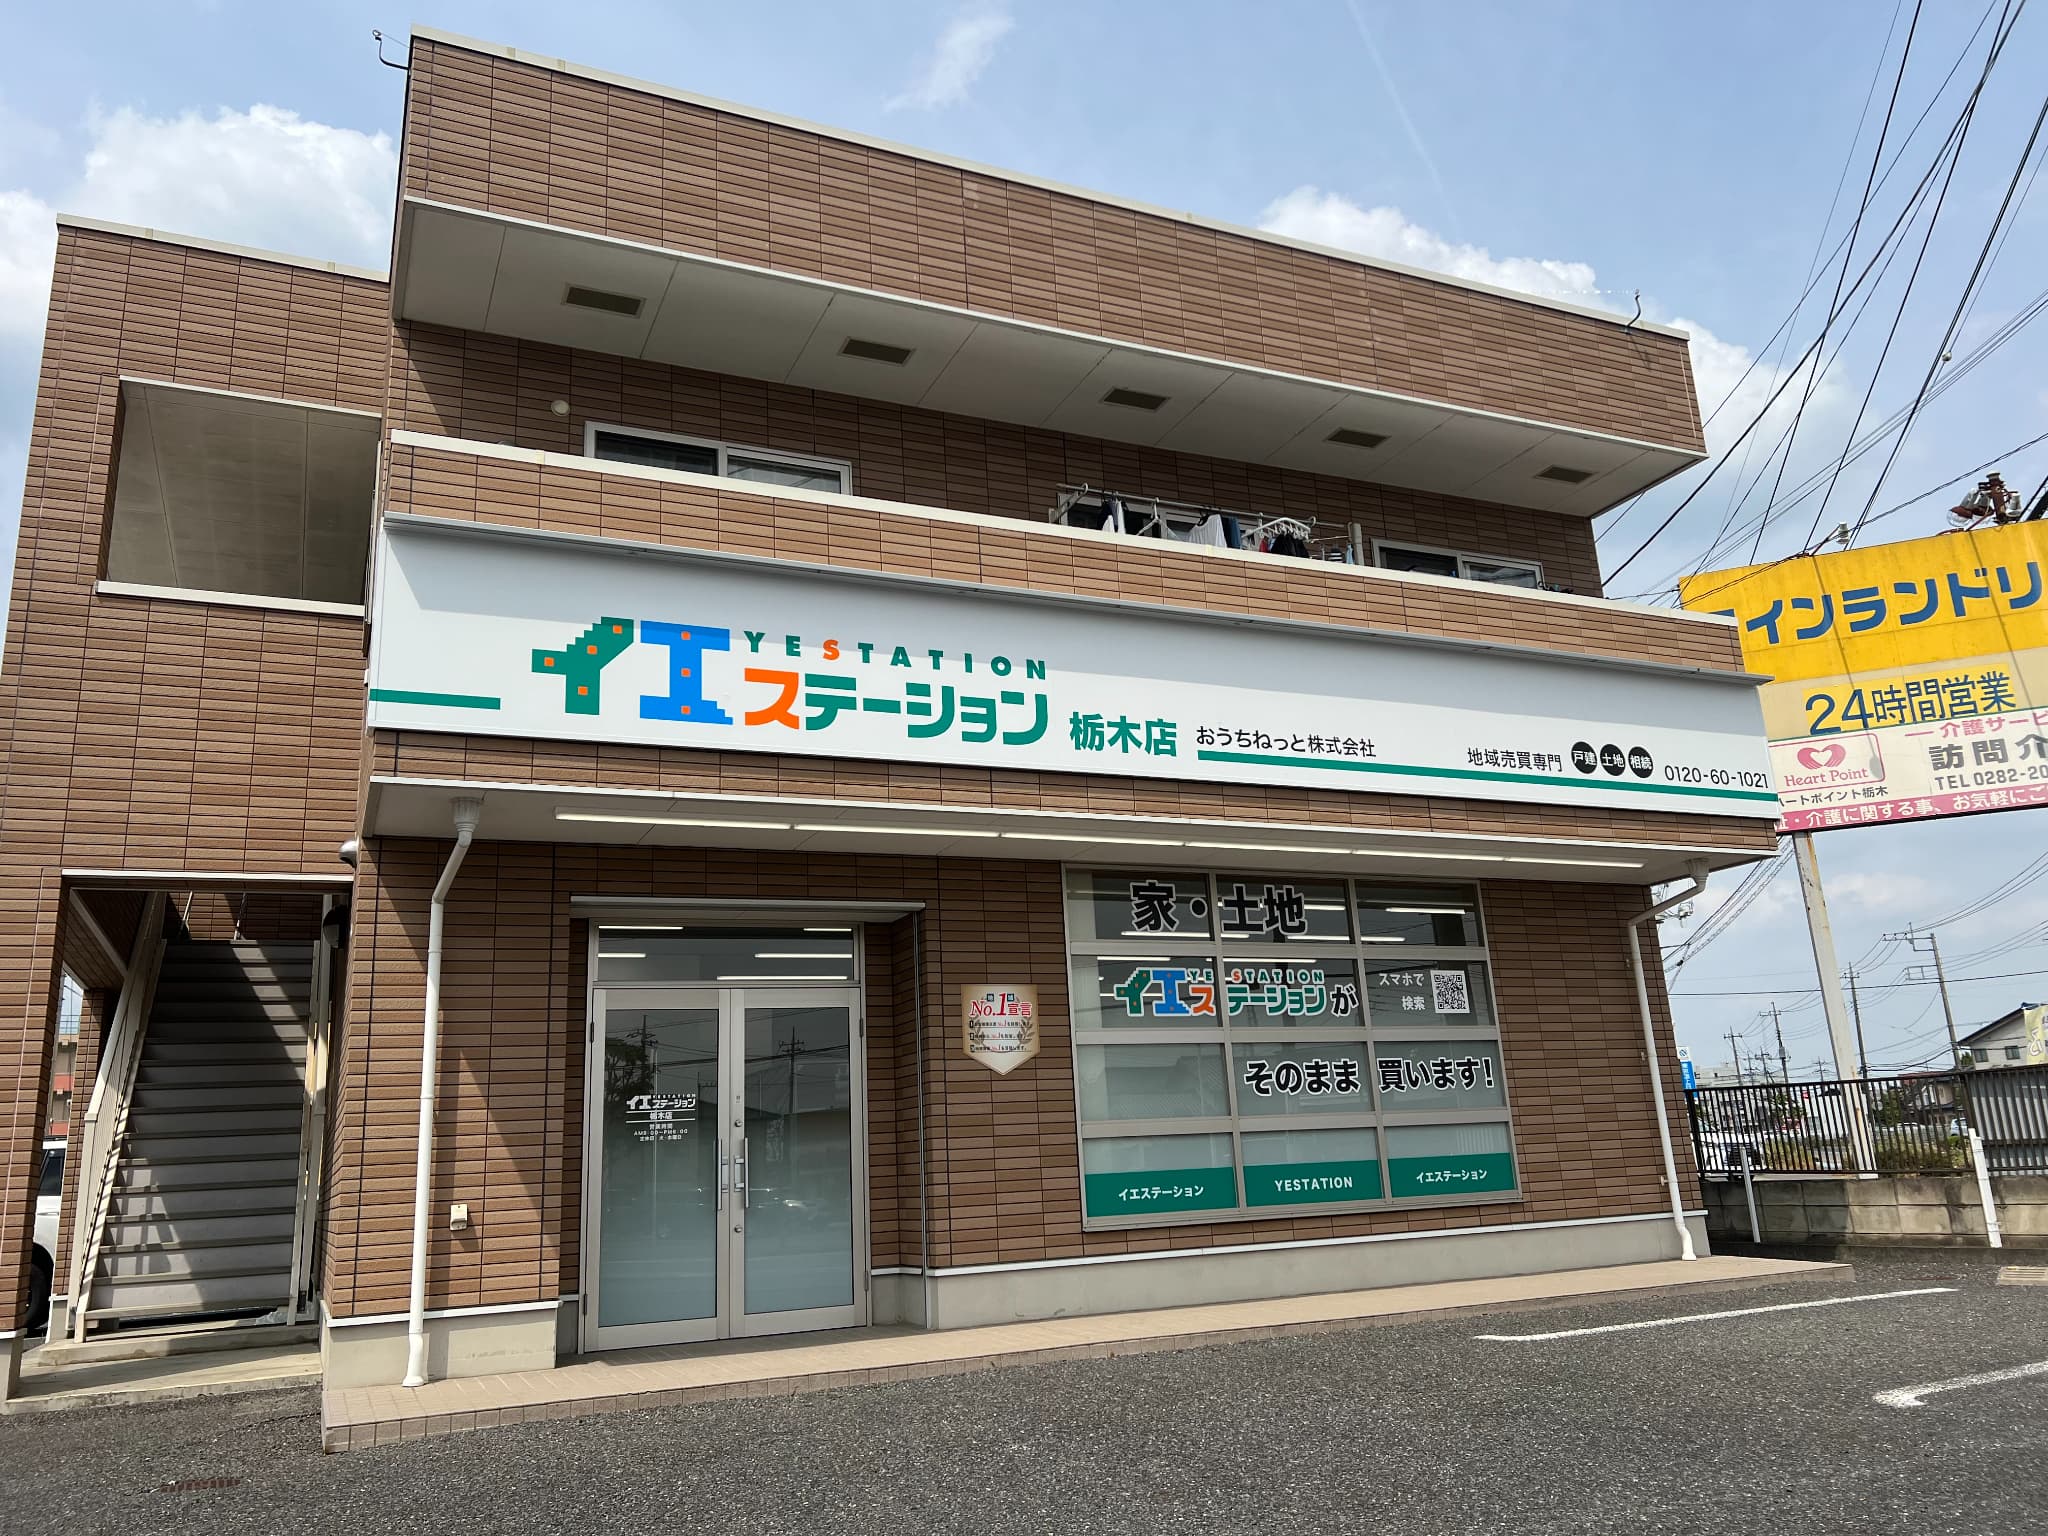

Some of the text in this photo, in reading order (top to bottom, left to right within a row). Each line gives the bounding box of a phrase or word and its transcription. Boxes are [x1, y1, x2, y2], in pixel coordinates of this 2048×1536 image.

[1709, 562, 2042, 644] インランドリ
[743, 630, 1047, 681] YESTATION
[531, 616, 1177, 757] イエステーション 栃木店
[1805, 671, 2017, 735] 24時間営業
[1196, 726, 1377, 758] おうちねっと株式会社
[1467, 747, 1769, 789] 地域売買専門 戸建 土地 相続 0120-60-1021
[1784, 767, 1869, 787] Heart Point
[1934, 774, 1970, 790] TEL
[1379, 973, 1425, 986] スマホで
[1401, 995, 1426, 1011] 検索
[1243, 1059, 1361, 1096] そのまま
[626, 1094, 696, 1110] イエステーション
[1274, 1175, 1354, 1192] YESTATION
[1416, 1168, 1488, 1184] イエステーション
[1118, 1185, 1204, 1202] イエステーション
